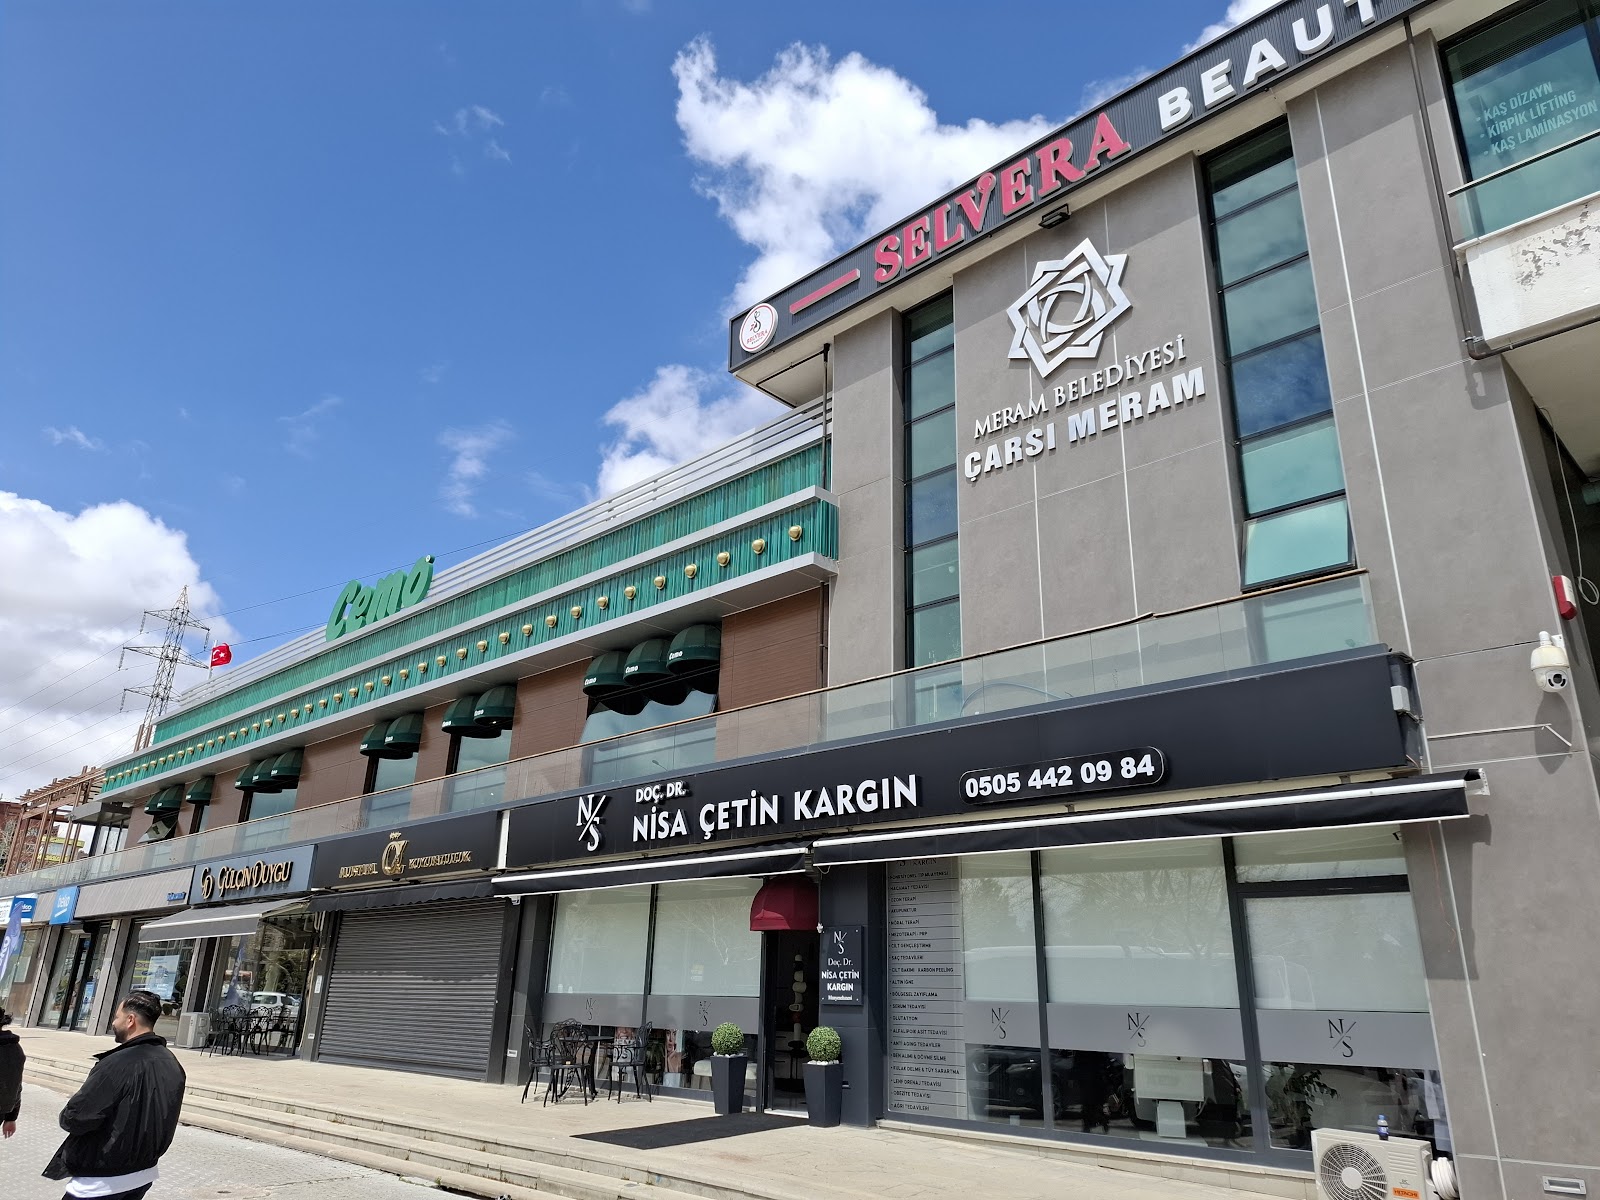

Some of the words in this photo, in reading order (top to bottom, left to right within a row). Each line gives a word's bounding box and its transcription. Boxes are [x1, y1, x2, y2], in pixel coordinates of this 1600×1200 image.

[1484, 101, 1507, 120] KAŞ
[1509, 81, 1553, 110] DİZAYN
[1487, 112, 1528, 138] KİRPİK
[1529, 90, 1577, 120] LİFTİNG
[1491, 136, 1516, 155] KAŞ
[1517, 100, 1598, 144] LAMİNASYON
[874, 112, 1131, 283] SELVERA
[974, 393, 1048, 439] MERAM
[1053, 334, 1186, 408] BELEDİYESİ
[1068, 367, 1206, 442] MERAM
[636, 786, 663, 804] DOÇ.
[666, 781, 687, 799] DR.
[965, 772, 1021, 797] 0505
[1028, 765, 1073, 789] 442
[1080, 760, 1112, 783] 09
[1120, 754, 1155, 779] 84
[633, 803, 688, 842] NİSA
[699, 790, 779, 840] ÇETİN
[794, 774, 918, 821] KARGIN
[252, 860, 292, 888] DUYGU
[821, 969, 837, 979] NİSA
[839, 969, 860, 981] ÇETİN
[827, 958, 842, 967] Doç.
[843, 958, 853, 966] Dr.
[827, 983, 853, 991] KARGIN
